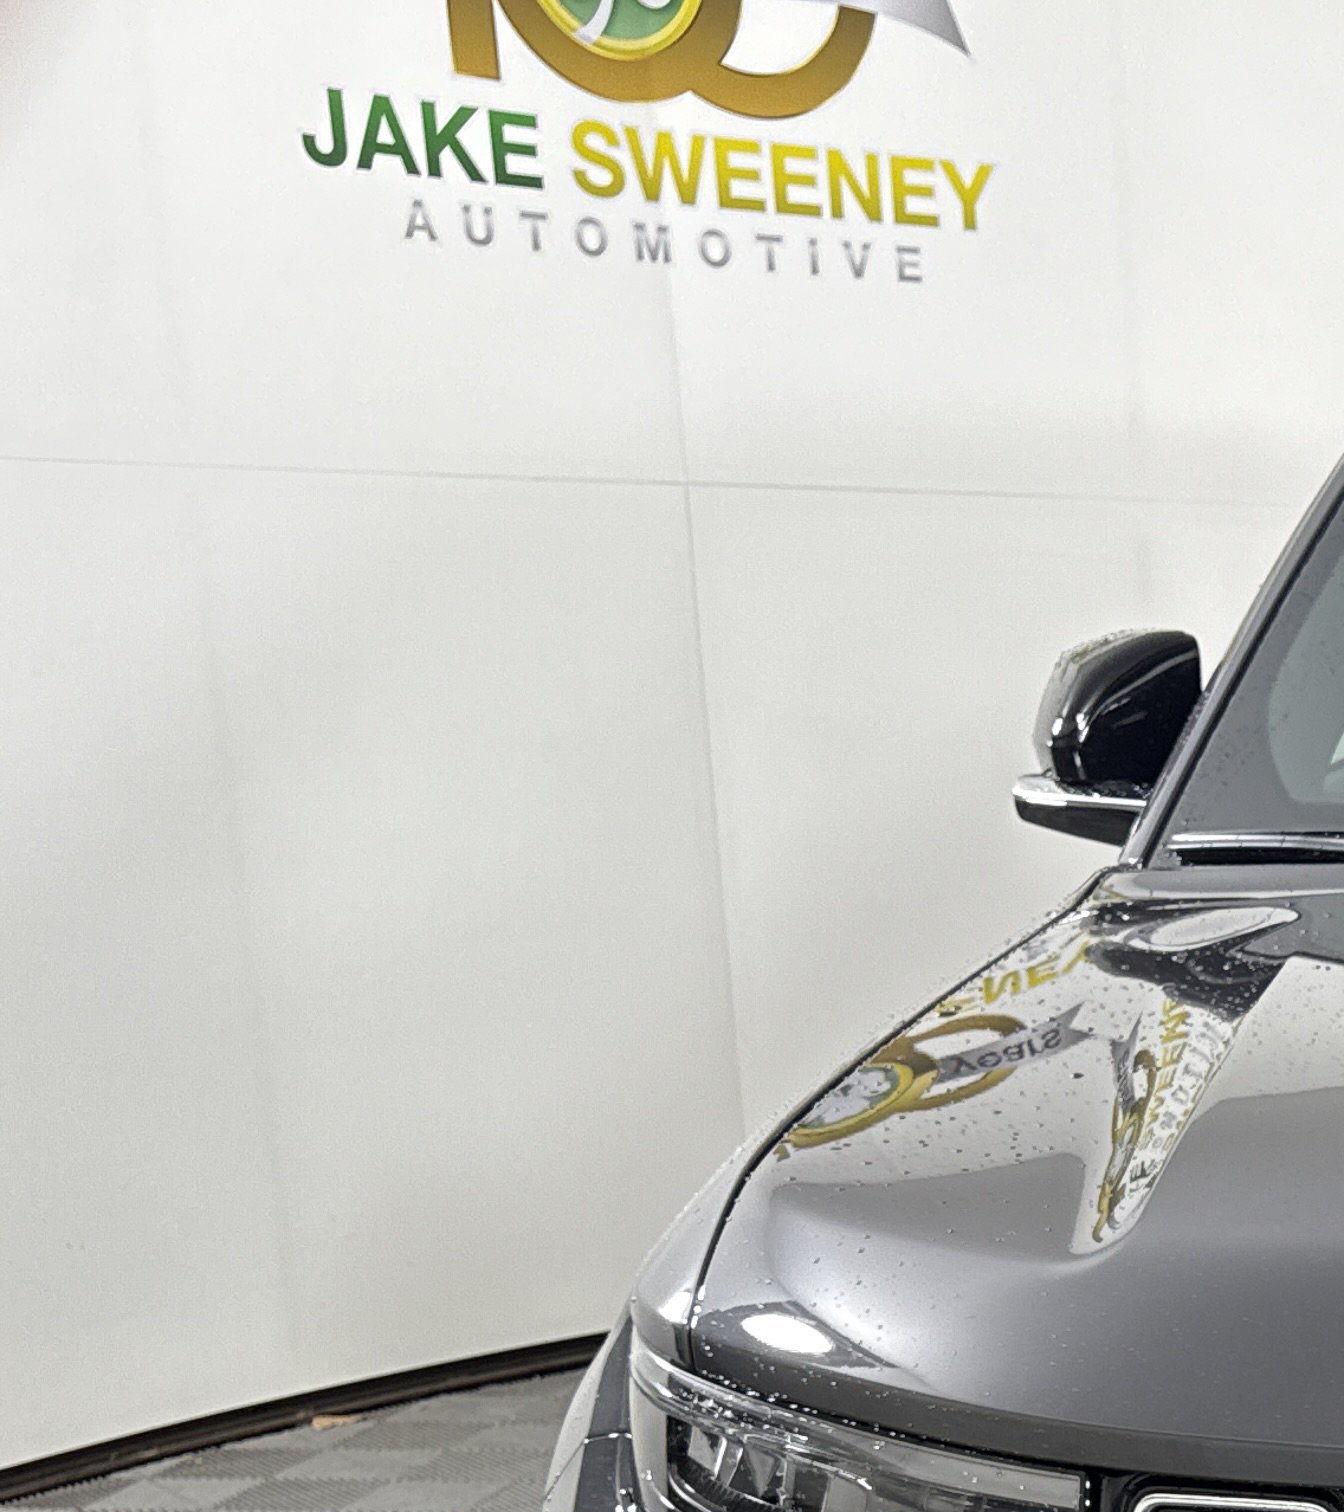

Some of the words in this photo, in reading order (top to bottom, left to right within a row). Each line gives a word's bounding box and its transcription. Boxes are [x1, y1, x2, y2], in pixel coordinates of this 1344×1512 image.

[301, 88, 544, 189] JAKE
[571, 119, 993, 231] SWEENEY
[404, 199, 924, 283] AUTOMOTIVE
